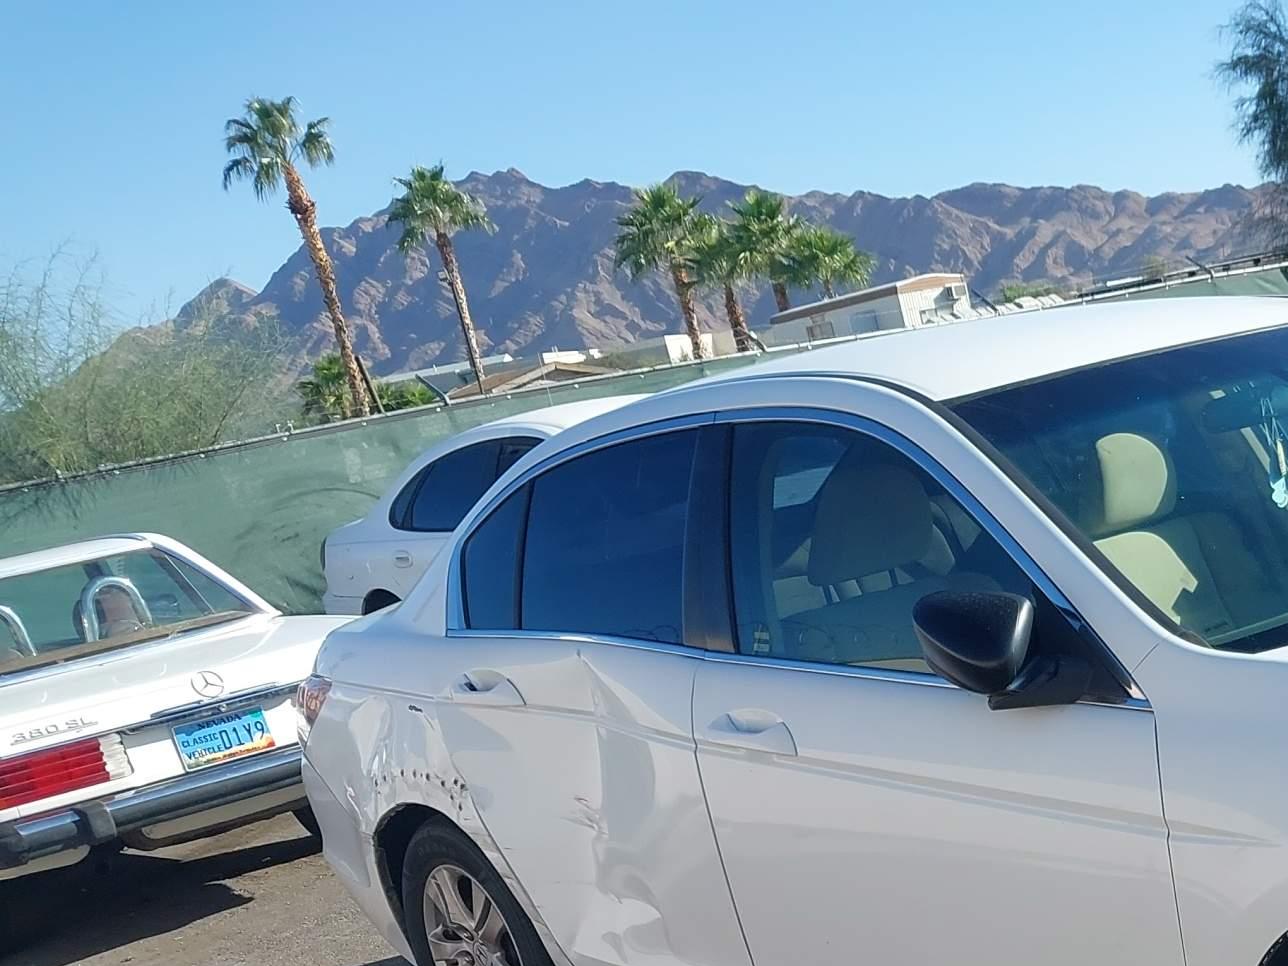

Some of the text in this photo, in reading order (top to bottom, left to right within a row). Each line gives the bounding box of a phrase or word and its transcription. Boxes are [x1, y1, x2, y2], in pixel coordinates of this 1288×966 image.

[64, 716, 99, 730] SL
[197, 713, 242, 730] NEVADA
[181, 732, 219, 749] CLASSIC
[185, 743, 225, 761] VEHICLE
